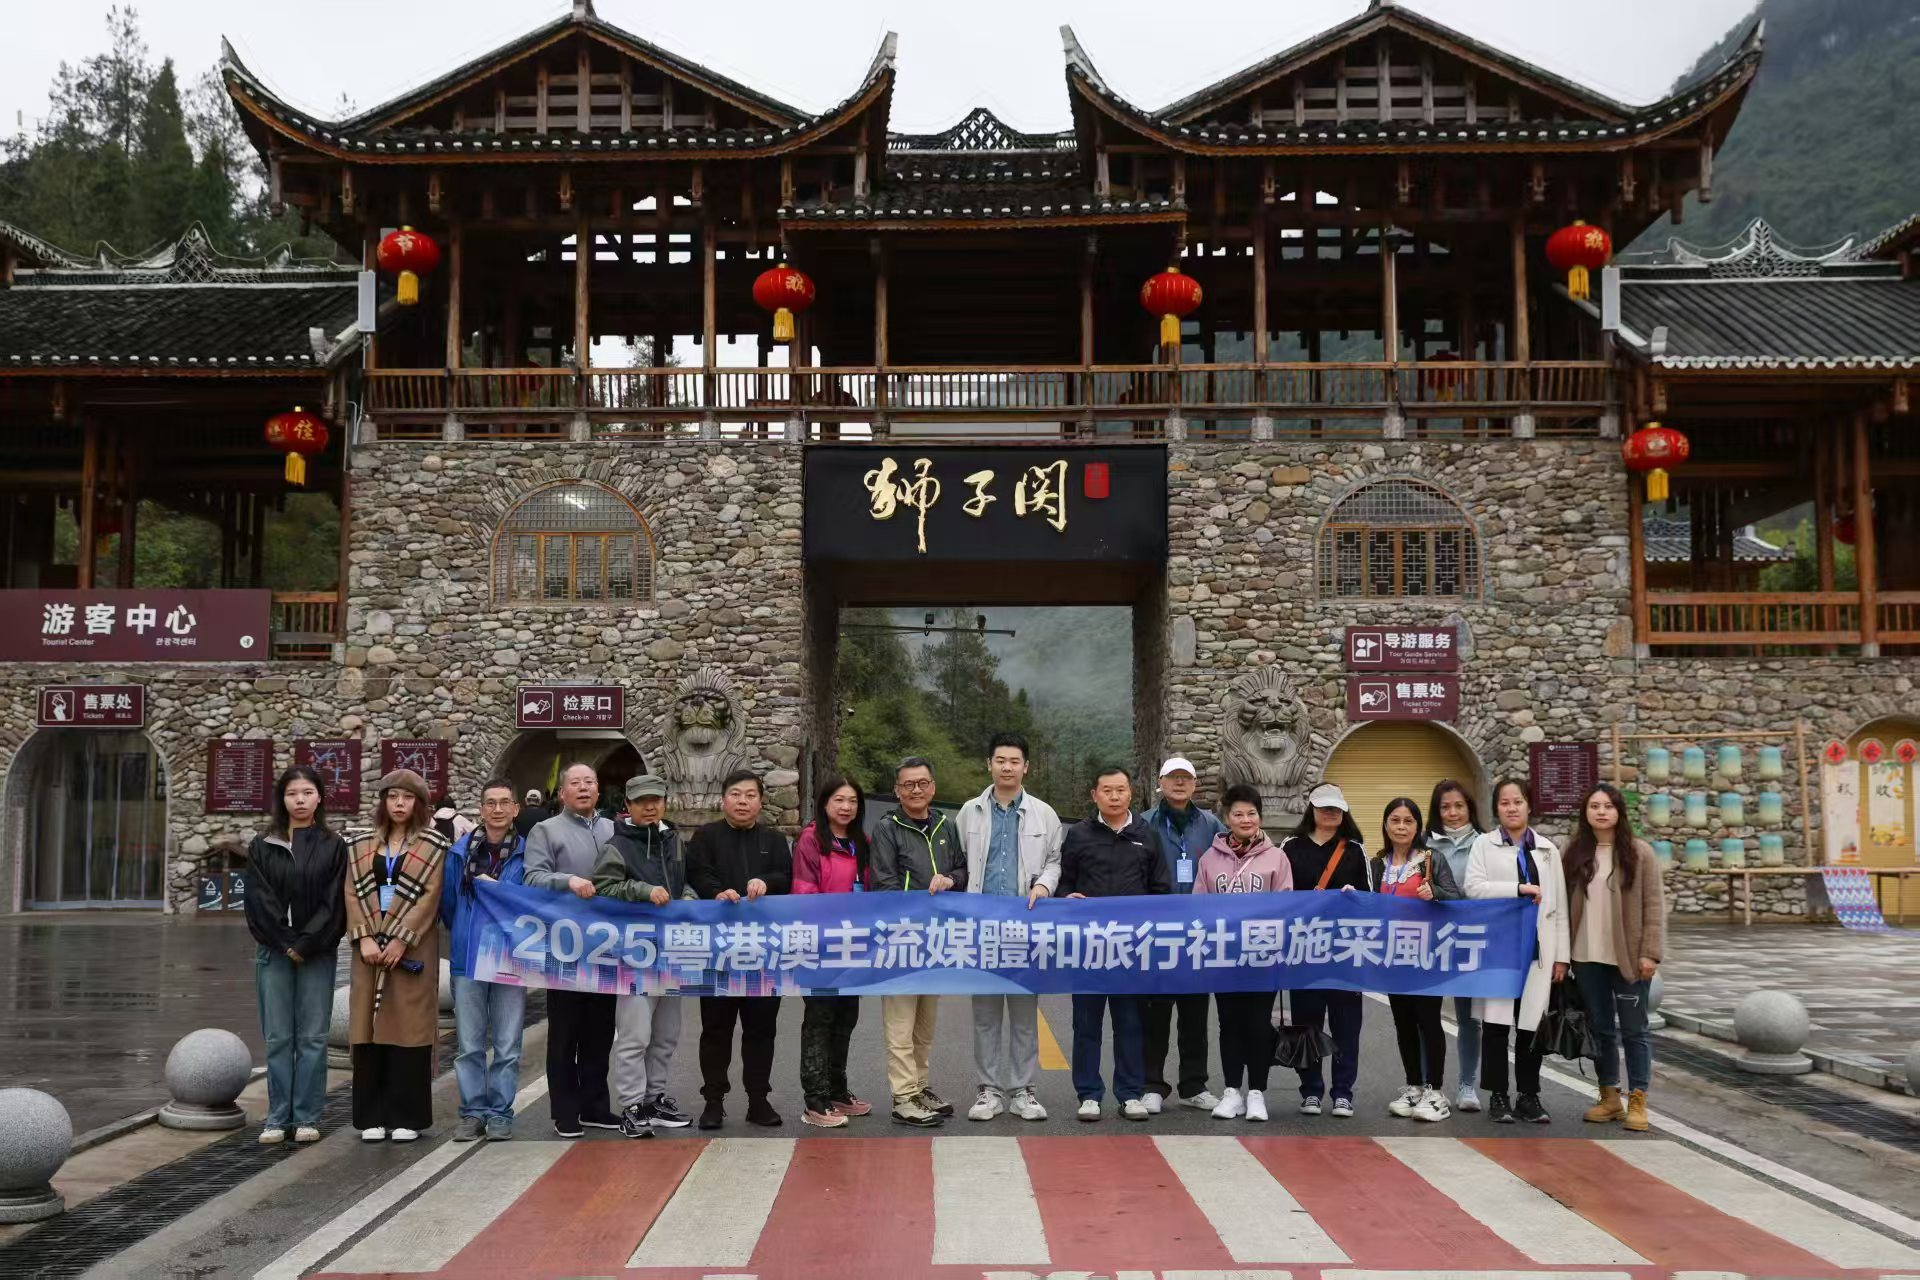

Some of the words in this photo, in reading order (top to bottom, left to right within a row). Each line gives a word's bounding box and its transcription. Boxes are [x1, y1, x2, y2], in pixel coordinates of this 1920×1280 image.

[41, 603, 197, 635] 游客中心
[42, 638, 67, 646] Tourist
[69, 638, 95, 646] Center
[156, 637, 196, 646] 관광객센터
[1384, 633, 1451, 649] 导游服务
[1396, 682, 1445, 698] 售票处
[83, 694, 132, 710] 售票处
[563, 695, 612, 711] 检票口
[1215, 872, 1264, 893] GAP
